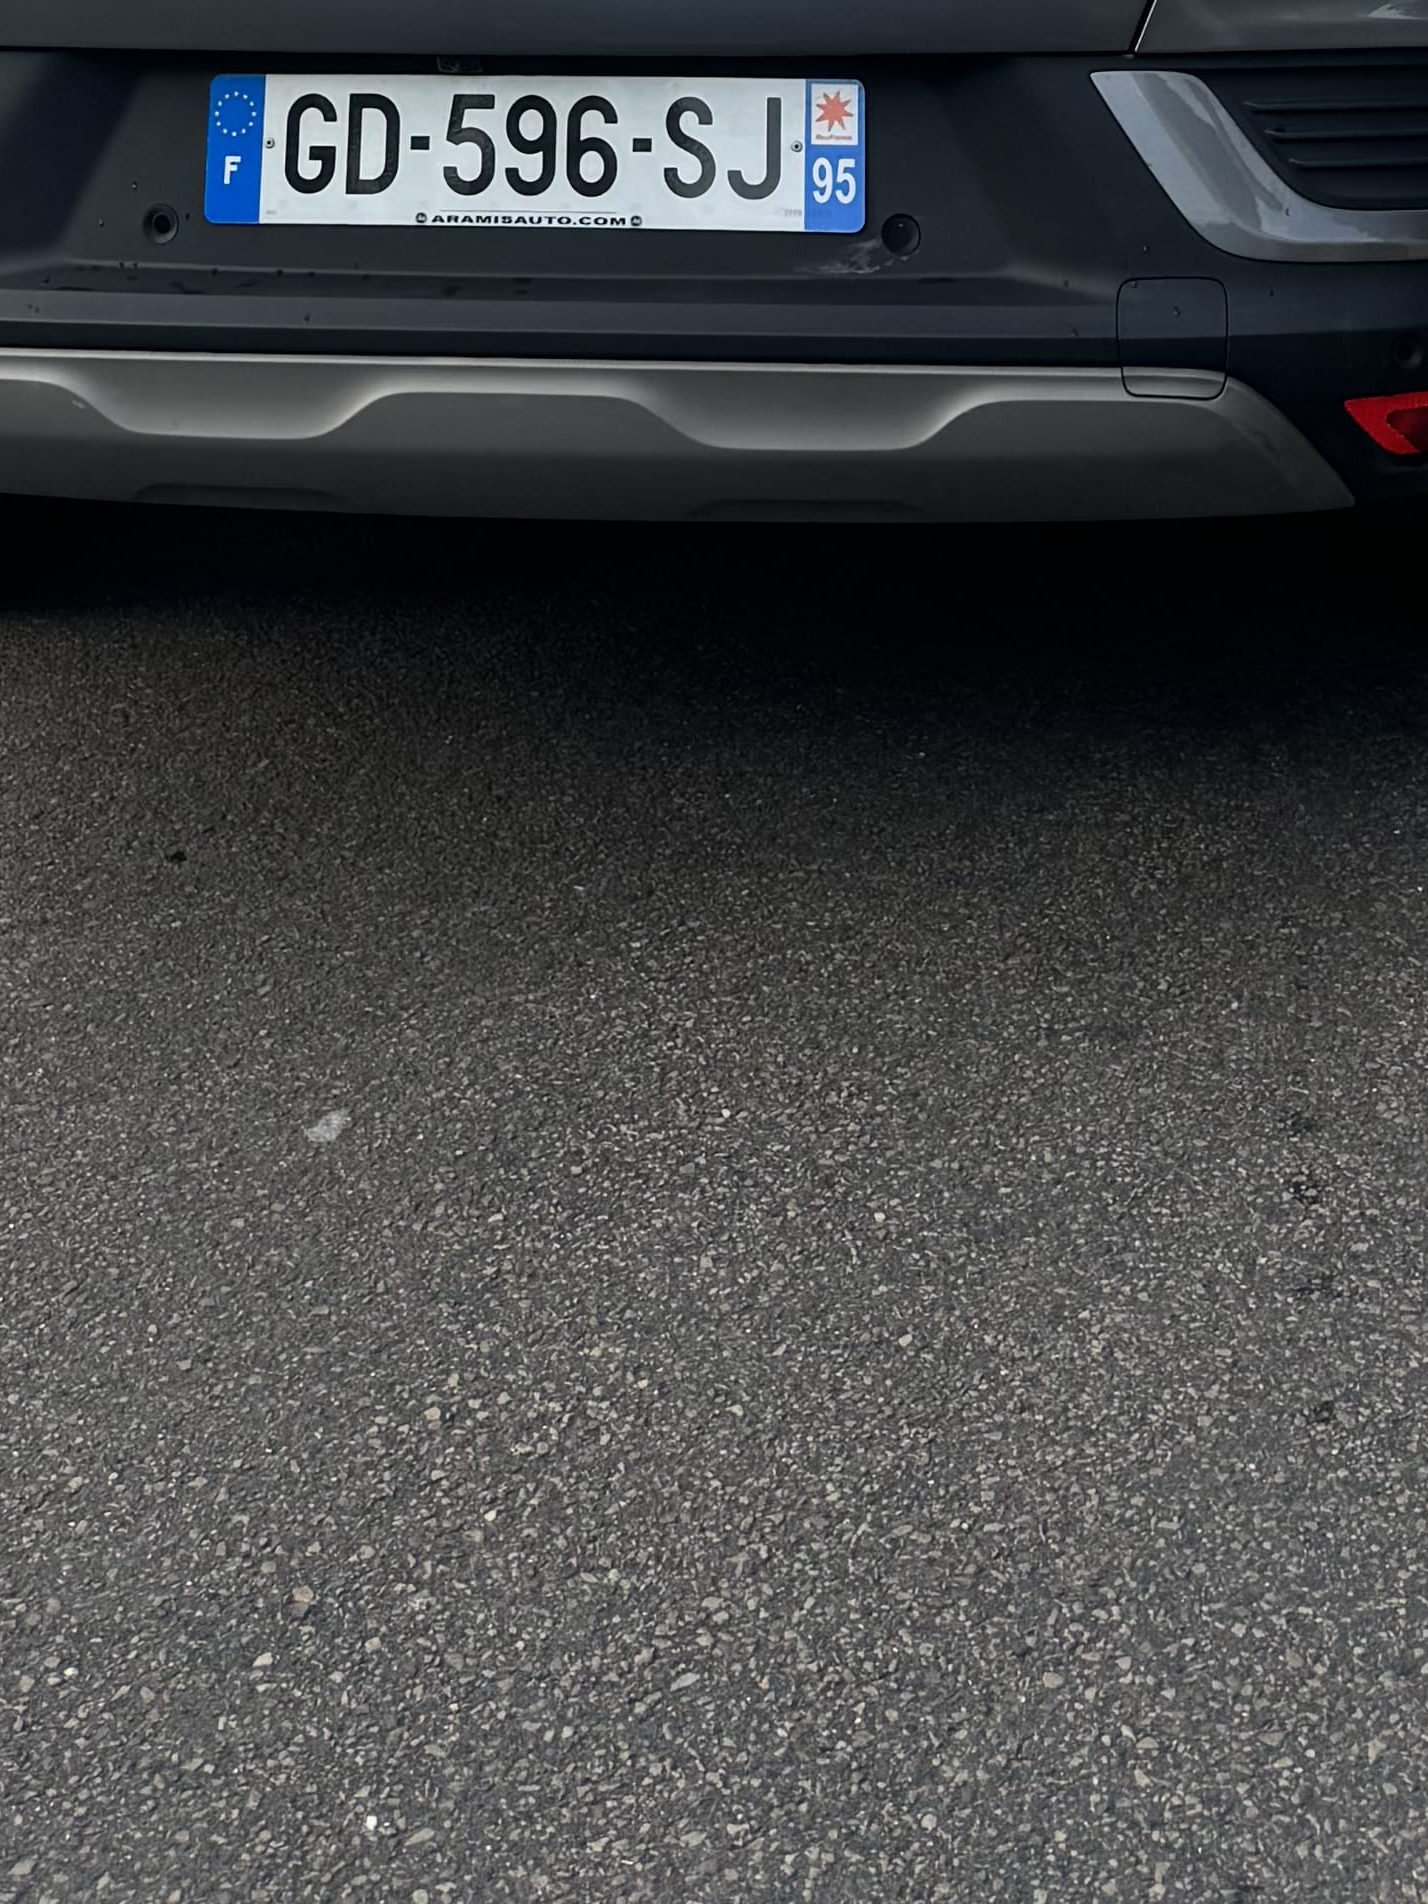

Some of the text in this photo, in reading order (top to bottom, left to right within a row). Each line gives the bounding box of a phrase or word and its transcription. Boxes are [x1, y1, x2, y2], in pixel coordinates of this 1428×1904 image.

[223, 93, 856, 205] F GD-596-SJ 95
[431, 214, 626, 226] ARAMISAUTO.COM
